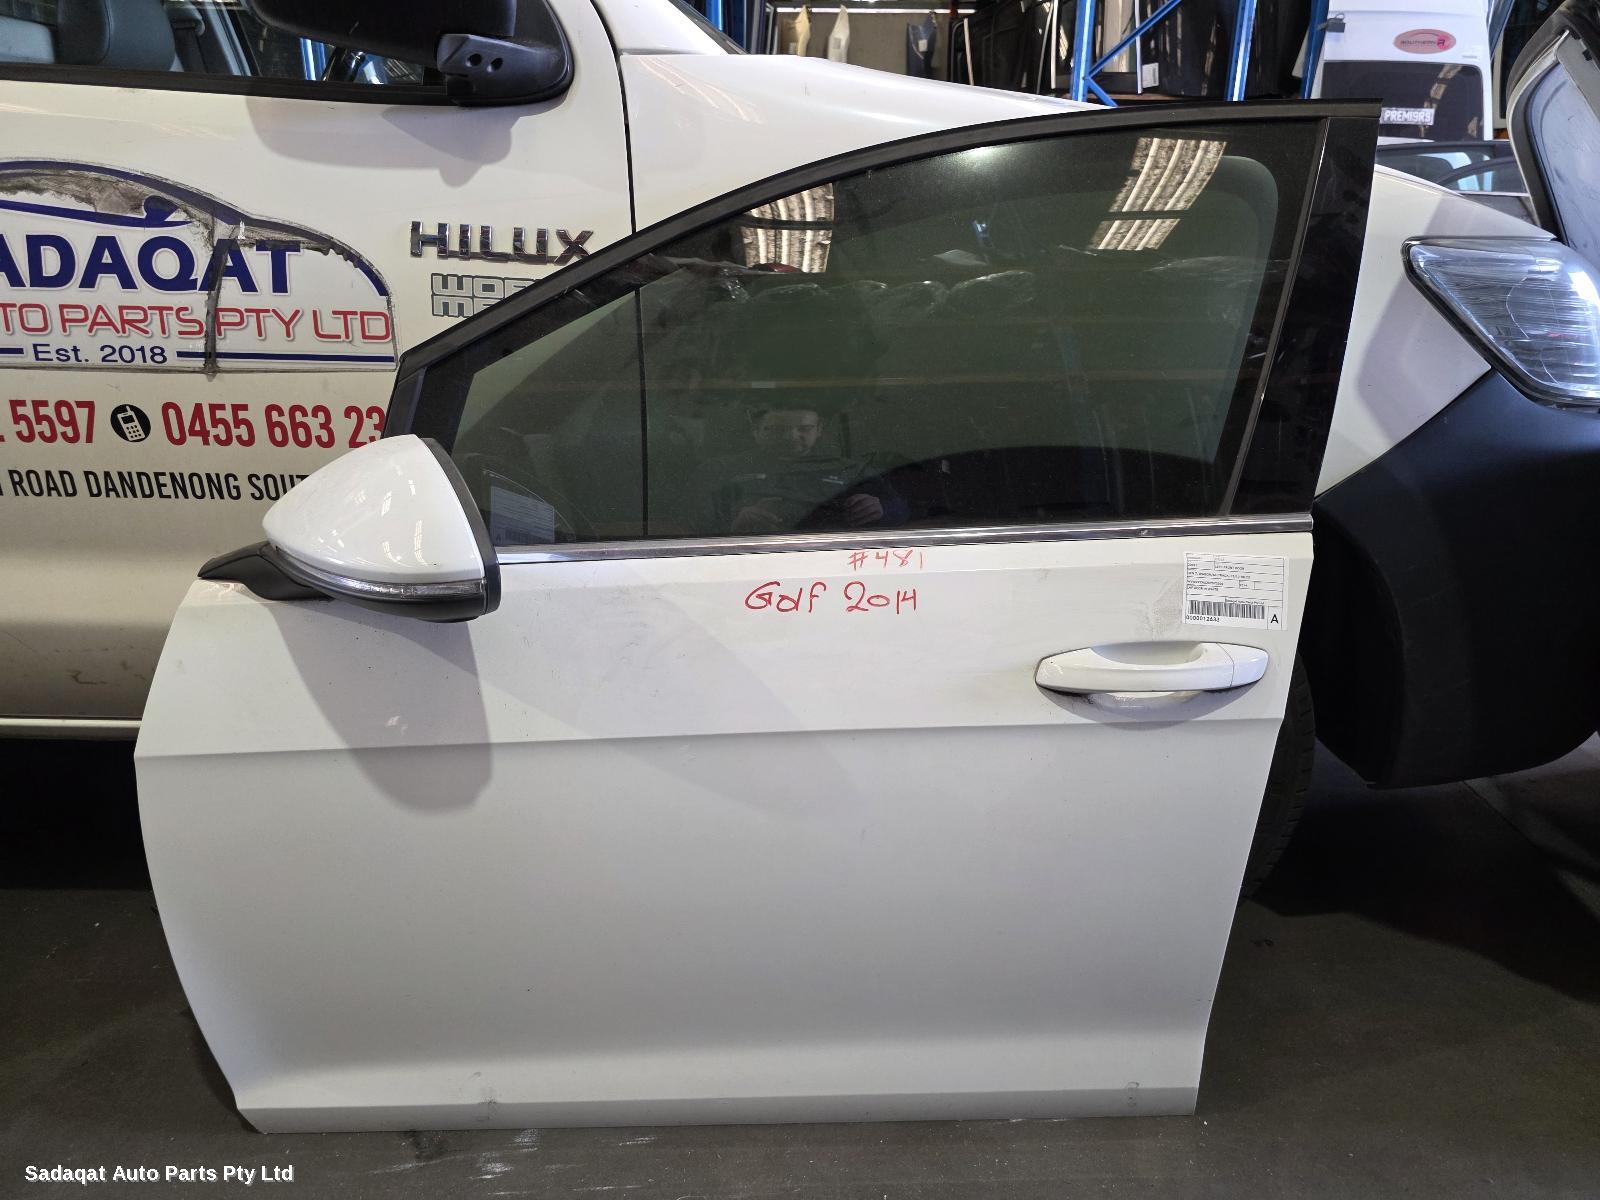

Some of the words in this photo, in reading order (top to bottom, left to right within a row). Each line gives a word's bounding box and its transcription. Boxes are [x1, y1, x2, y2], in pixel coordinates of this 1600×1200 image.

[410, 221, 594, 265] HILUX
[59, 304, 204, 337] PARTS
[217, 307, 300, 339] PTY
[312, 309, 391, 342] LTD
[32, 343, 89, 363] Est.
[100, 345, 168, 364] 2018
[9, 400, 96, 444] 5597
[161, 402, 255, 447] 0455
[264, 404, 335, 449] 663
[8, 469, 77, 498] ROAD
[84, 471, 241, 501] DANDENONG
[247, 473, 310, 501] SOU
[848, 550, 923, 571] #481
[843, 581, 917, 615] 2014
[1270, 613, 1279, 624] A
